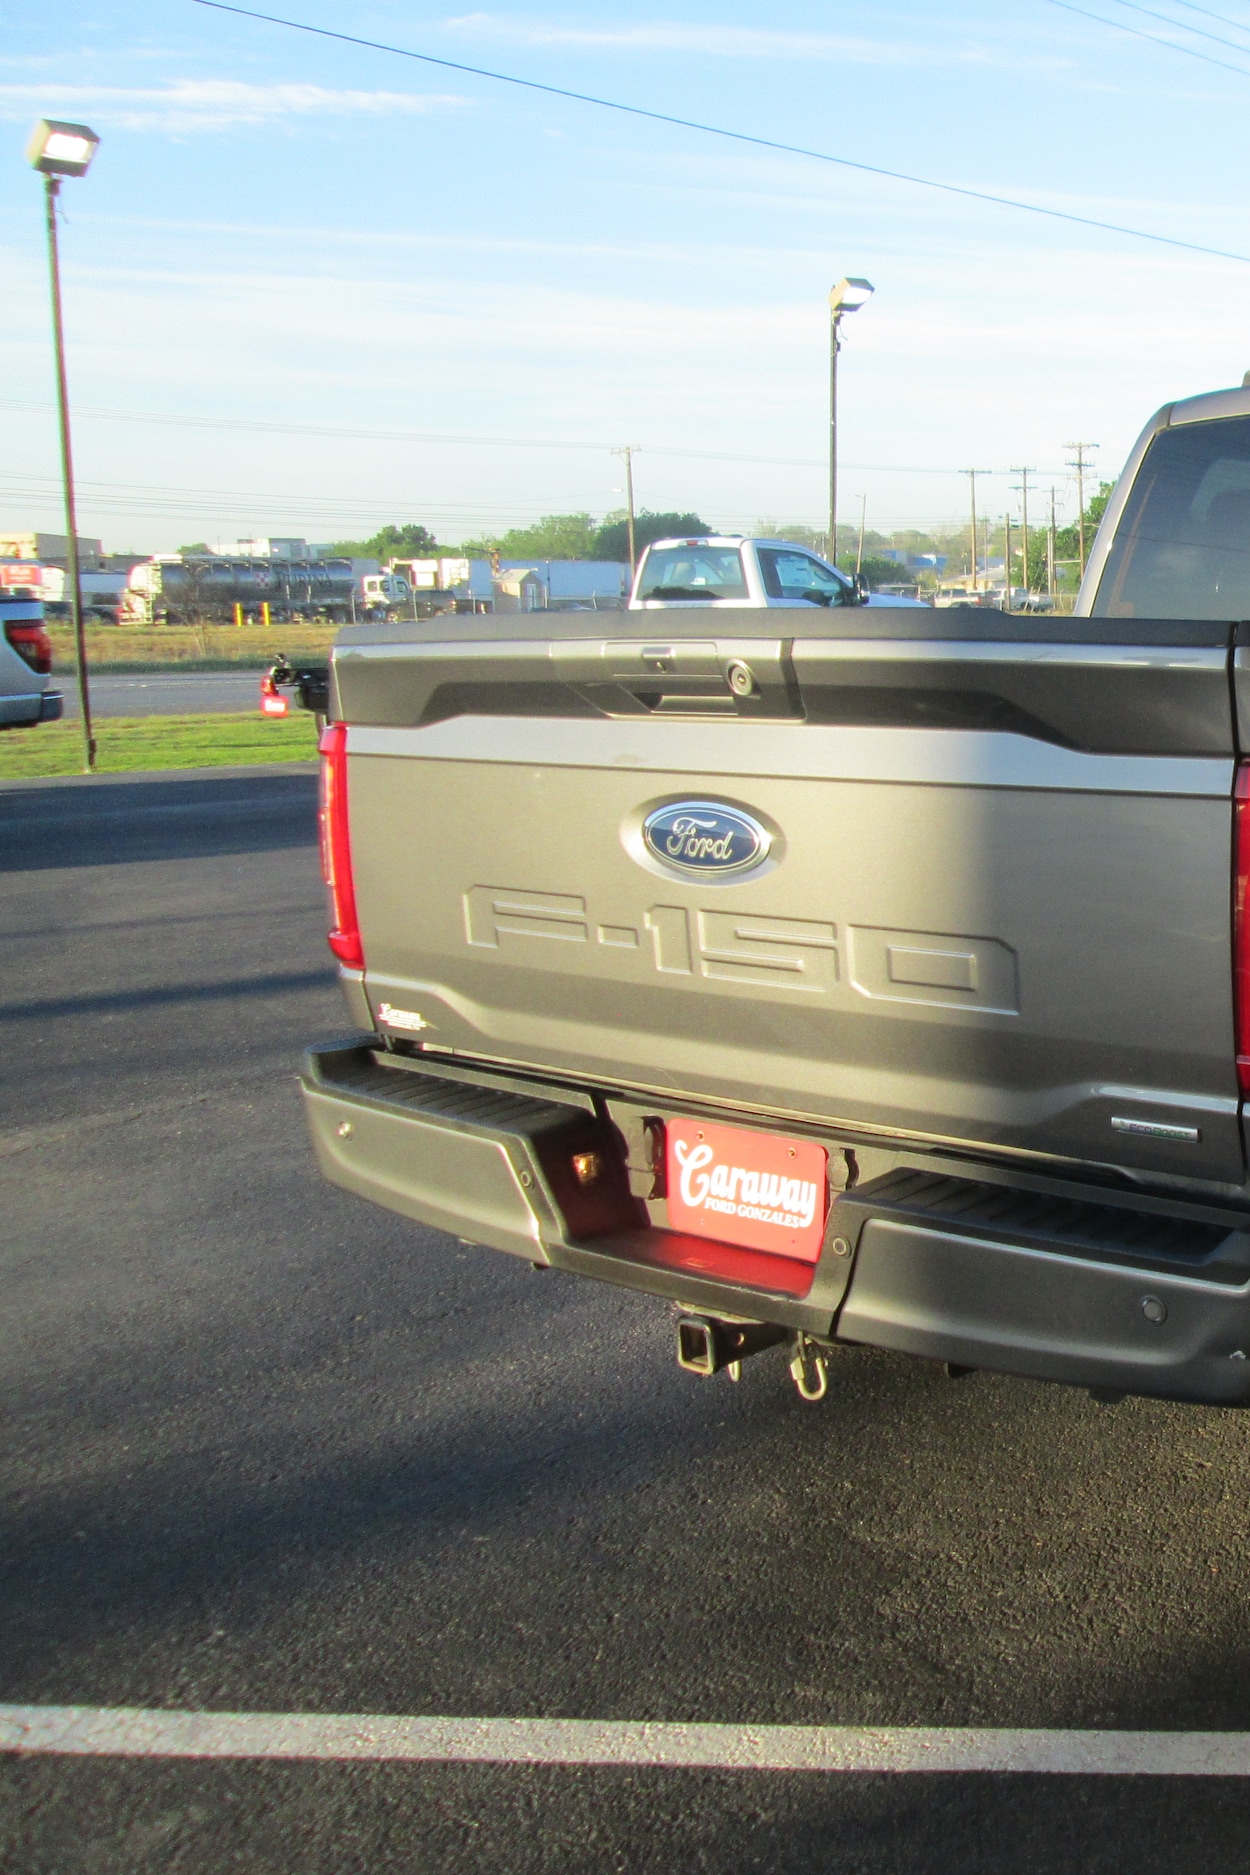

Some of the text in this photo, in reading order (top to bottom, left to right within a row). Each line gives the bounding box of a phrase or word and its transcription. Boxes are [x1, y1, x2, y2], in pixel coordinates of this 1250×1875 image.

[666, 816, 734, 860] Ford
[463, 883, 1020, 1016] F-150
[674, 1138, 817, 1228] Caraway
[704, 1196, 800, 1229] FORD GONZALES
